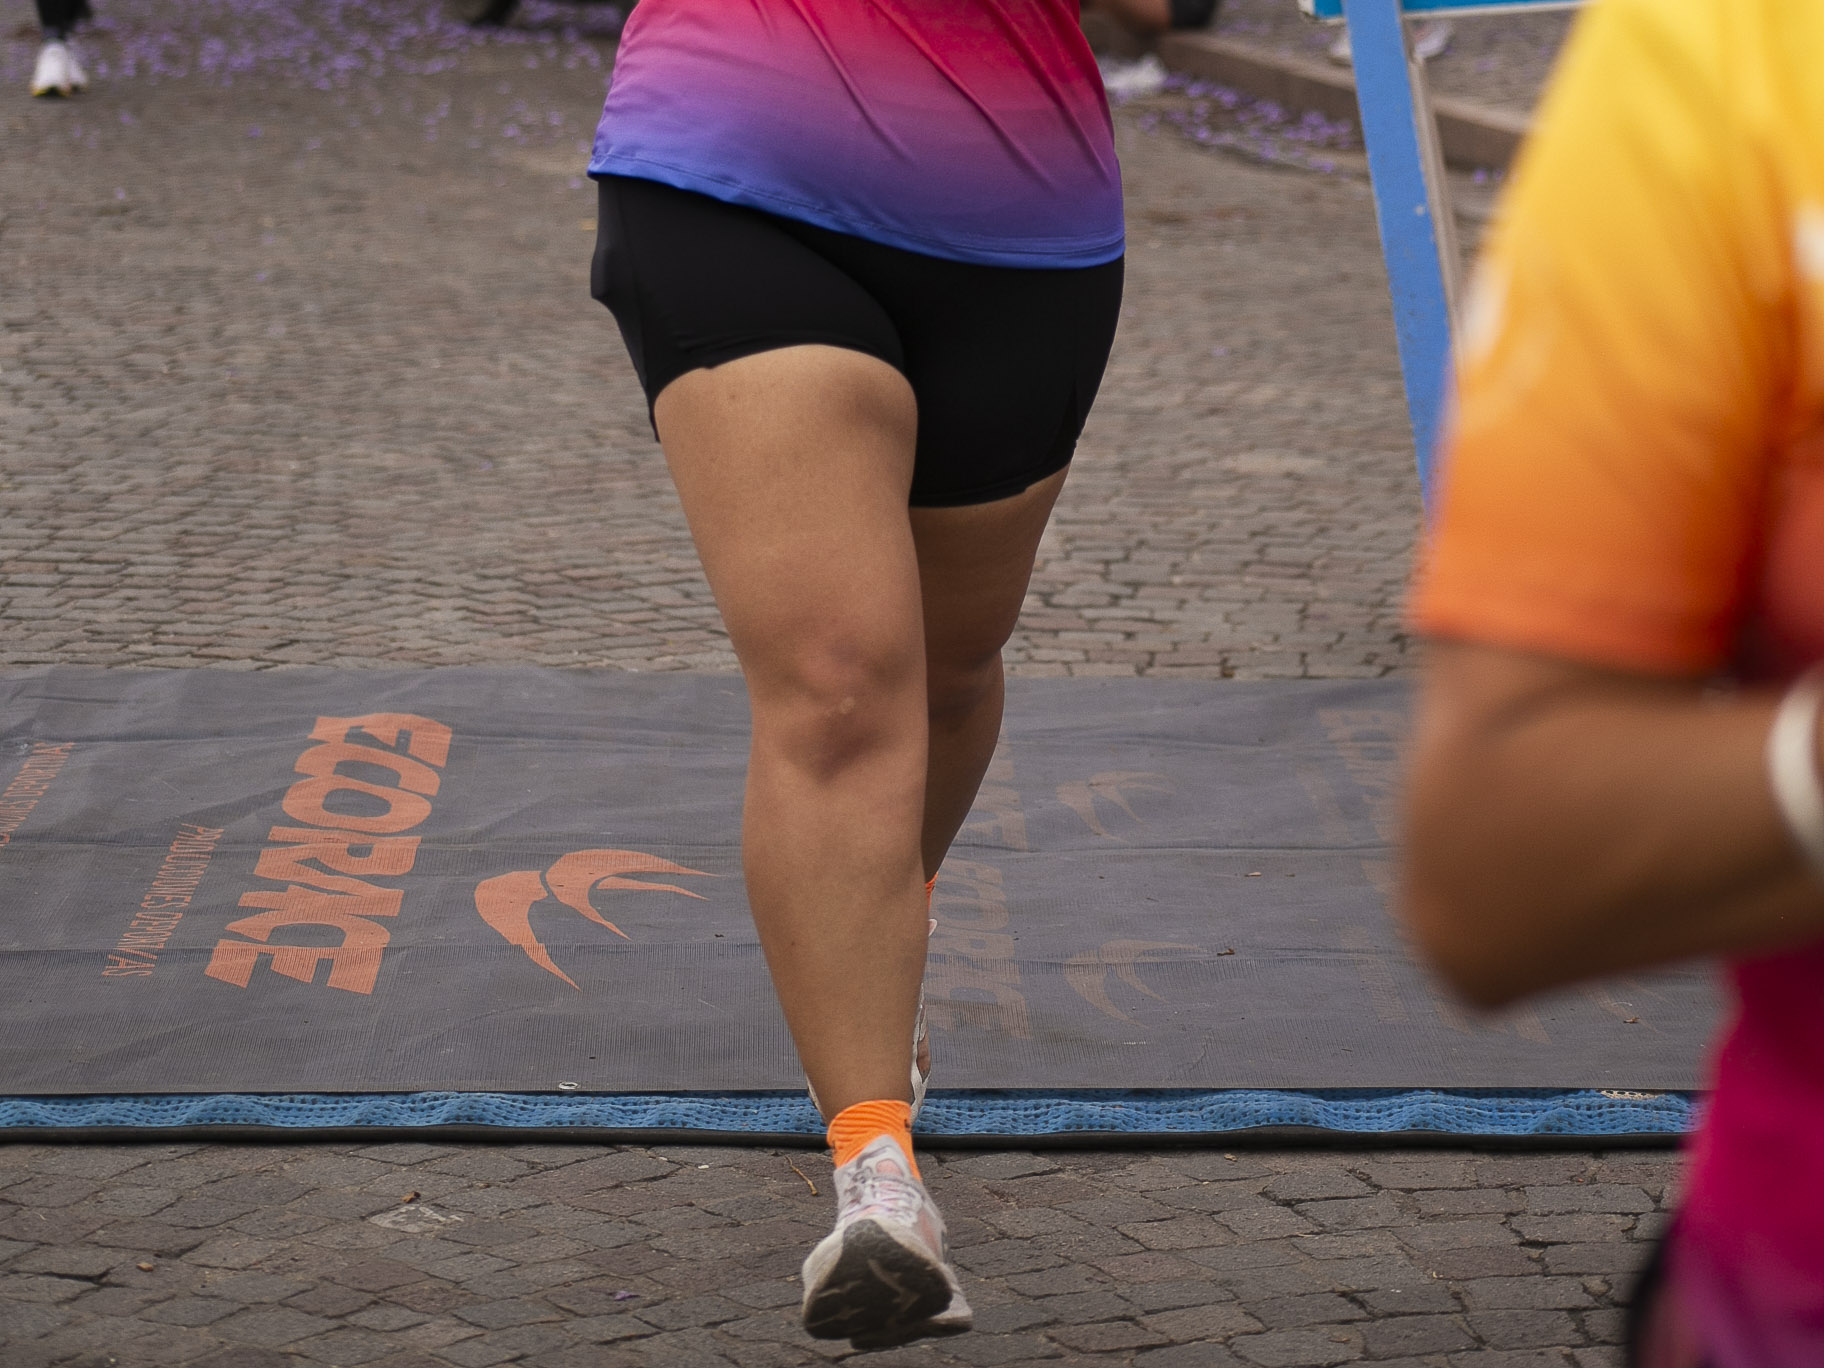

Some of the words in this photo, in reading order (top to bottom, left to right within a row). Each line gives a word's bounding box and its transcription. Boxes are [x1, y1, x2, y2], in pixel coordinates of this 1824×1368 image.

[140, 822, 225, 910] PRODUCCIONES
[204, 712, 453, 994] ECORACE
[101, 911, 184, 977] DEPORTVAS
